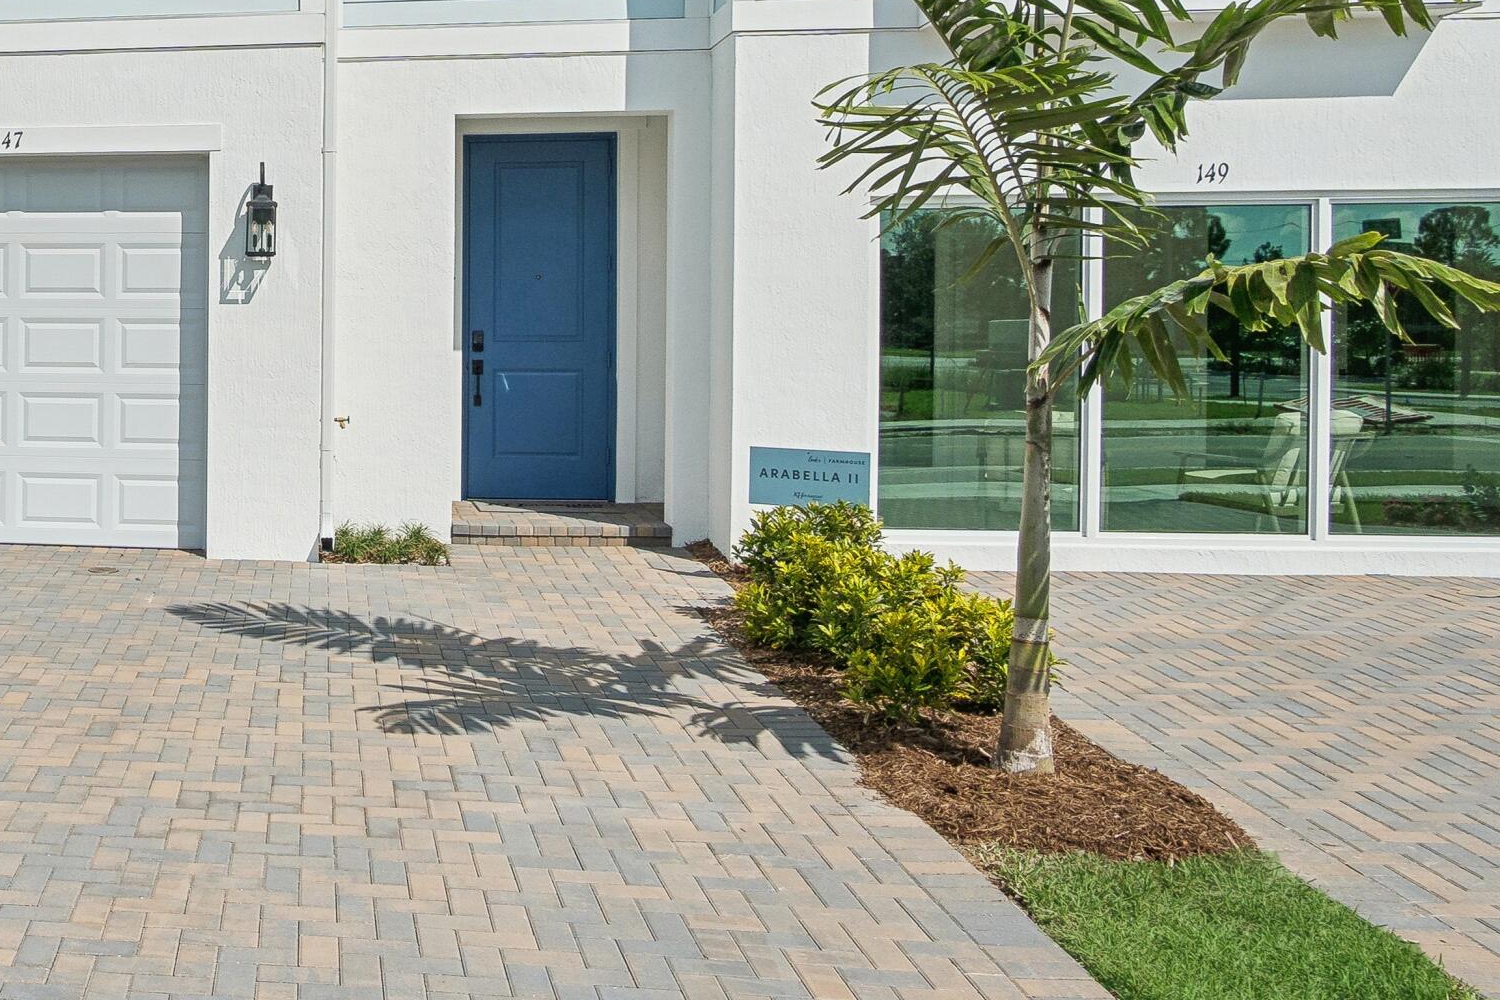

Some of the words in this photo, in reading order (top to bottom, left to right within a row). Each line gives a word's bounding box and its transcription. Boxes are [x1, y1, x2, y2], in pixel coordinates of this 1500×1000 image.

[1196, 162, 1229, 184] 149
[759, 467, 840, 483] ARABELLA
[848, 473, 859, 484] II
